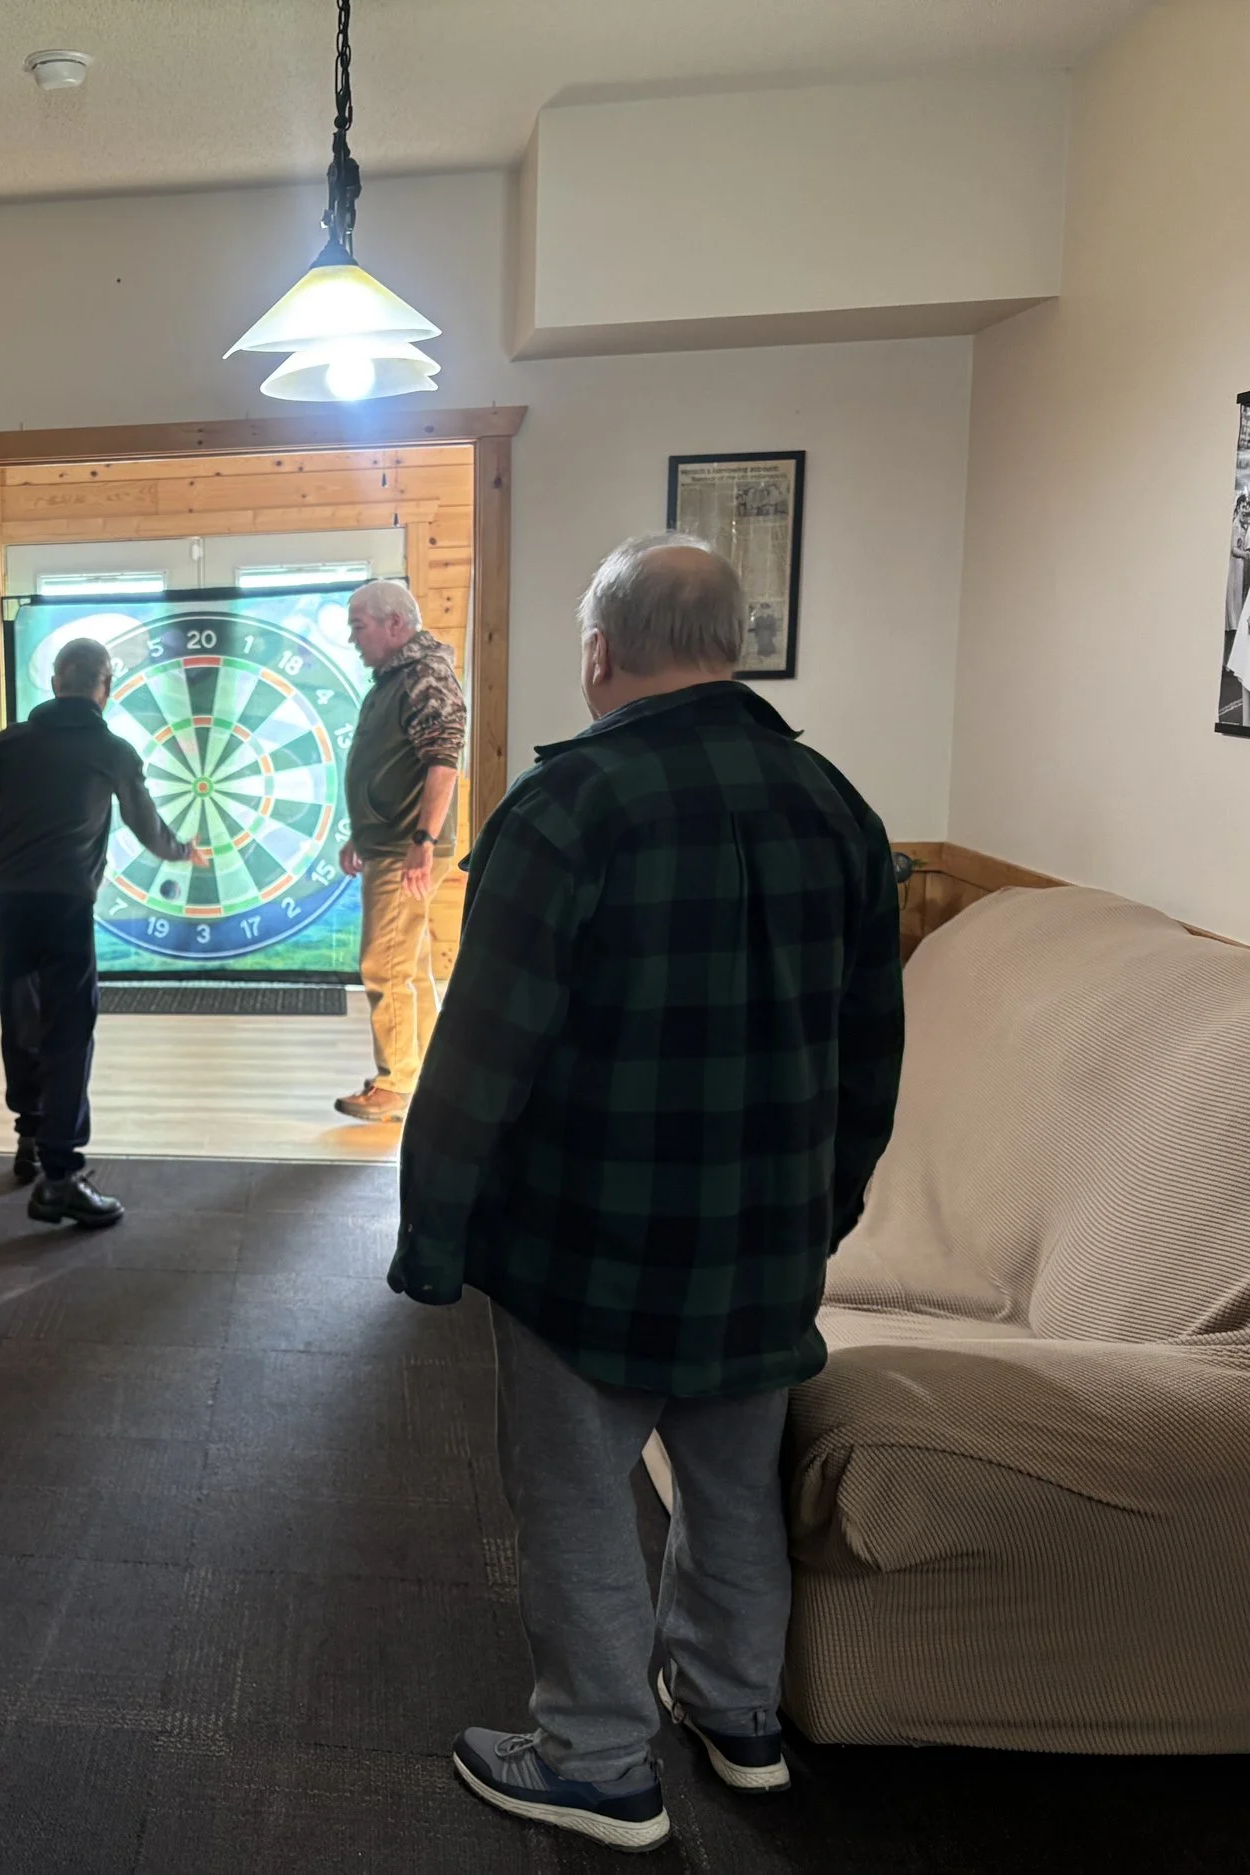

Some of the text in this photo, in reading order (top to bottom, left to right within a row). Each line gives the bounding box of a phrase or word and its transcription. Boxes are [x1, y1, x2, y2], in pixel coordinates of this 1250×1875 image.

[148, 638, 164, 657] 5
[186, 630, 217, 649] 20
[244, 635, 254, 653] 1
[278, 651, 303, 675] 18
[316, 689, 334, 705] 4
[312, 860, 336, 886] 15
[109, 897, 128, 916] 7
[281, 897, 301, 918] 2
[147, 916, 170, 938] 19
[196, 924, 211, 944] 3
[240, 915, 261, 939] 17
